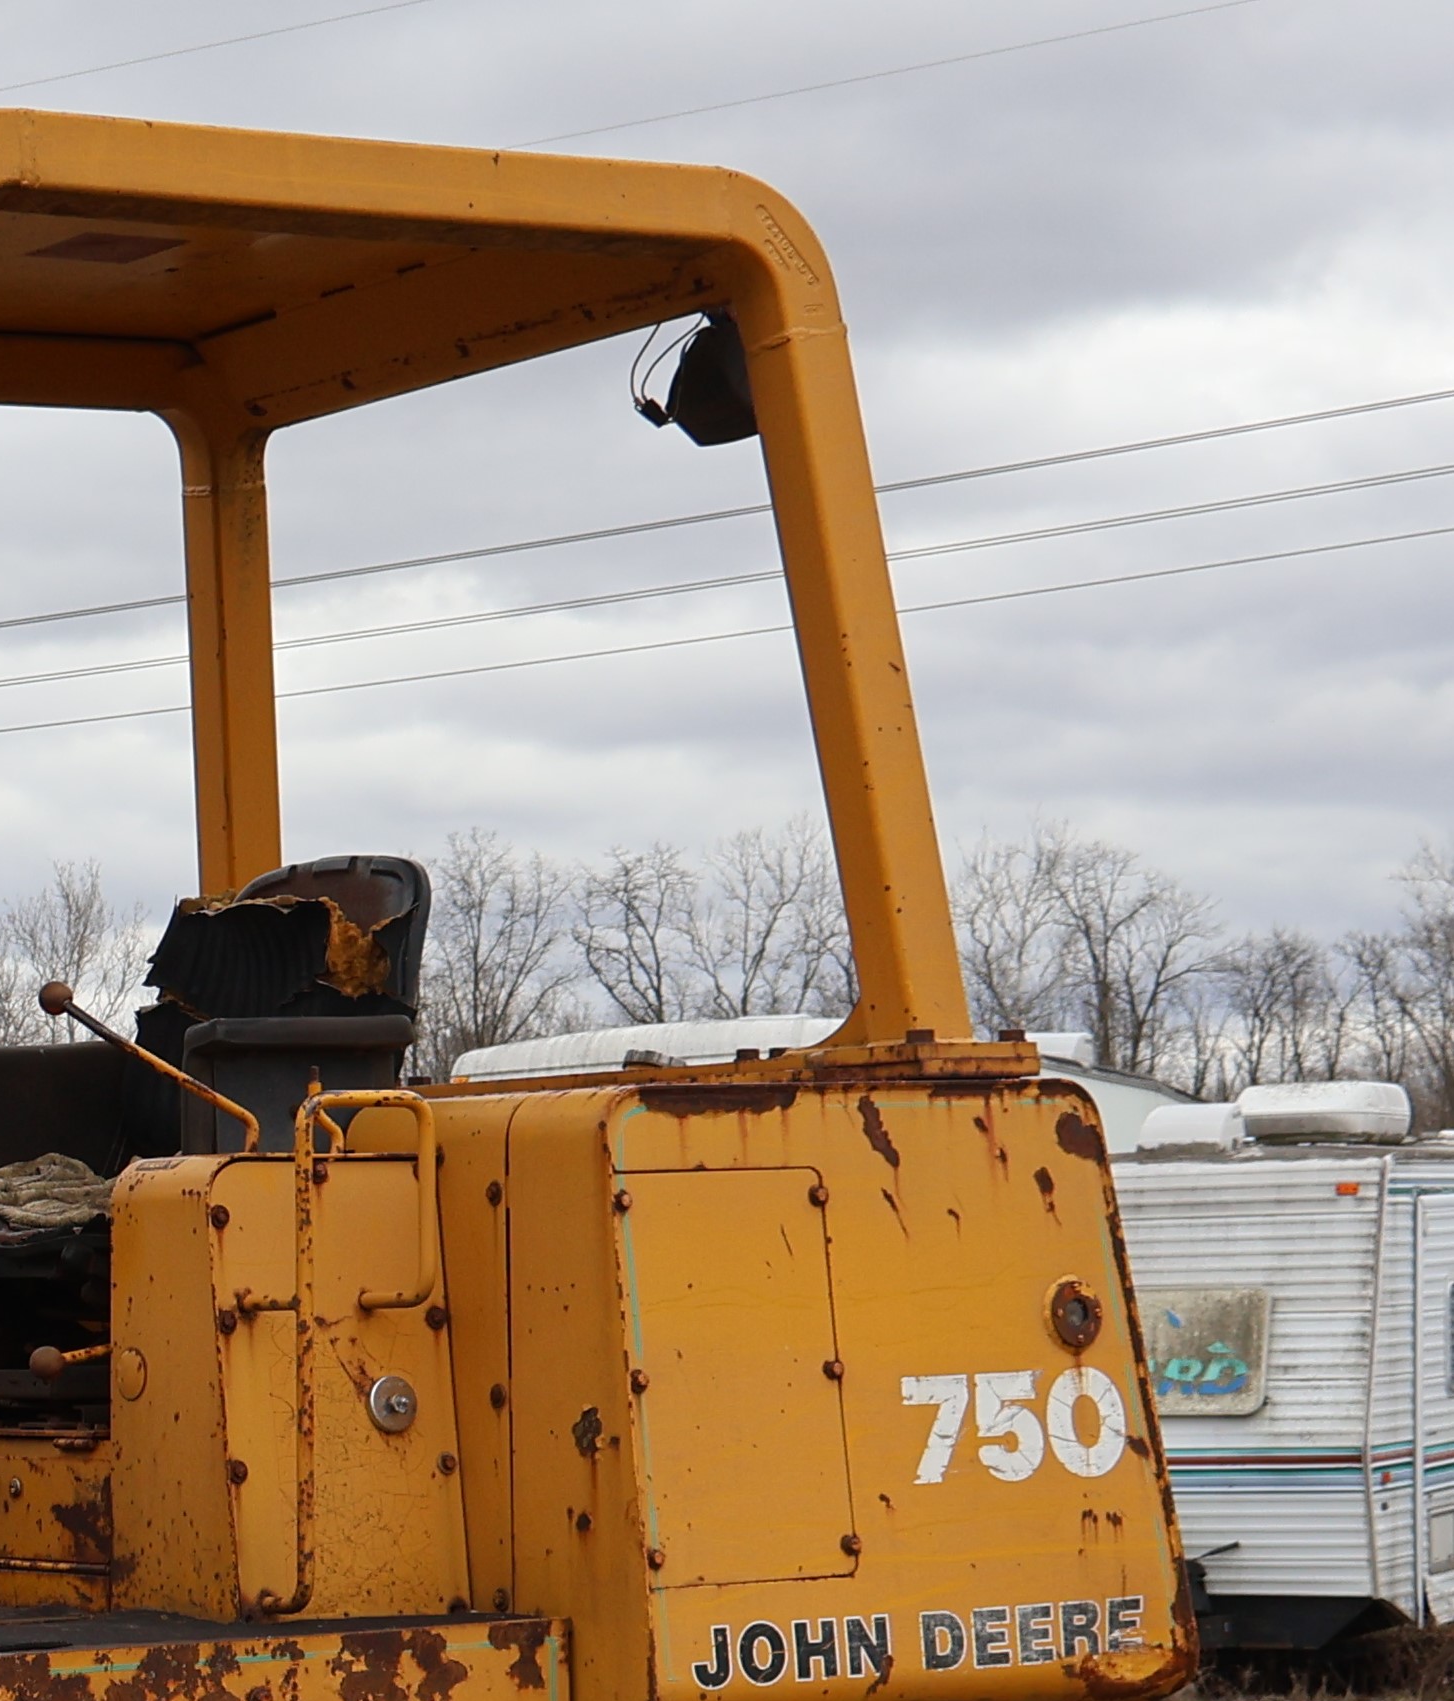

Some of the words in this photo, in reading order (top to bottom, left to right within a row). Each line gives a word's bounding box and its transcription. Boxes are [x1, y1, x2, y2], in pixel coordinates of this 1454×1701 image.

[900, 1366, 1127, 1485] 750
[692, 1613, 893, 1691] JOHN
[919, 1595, 1144, 1672] DEERE
